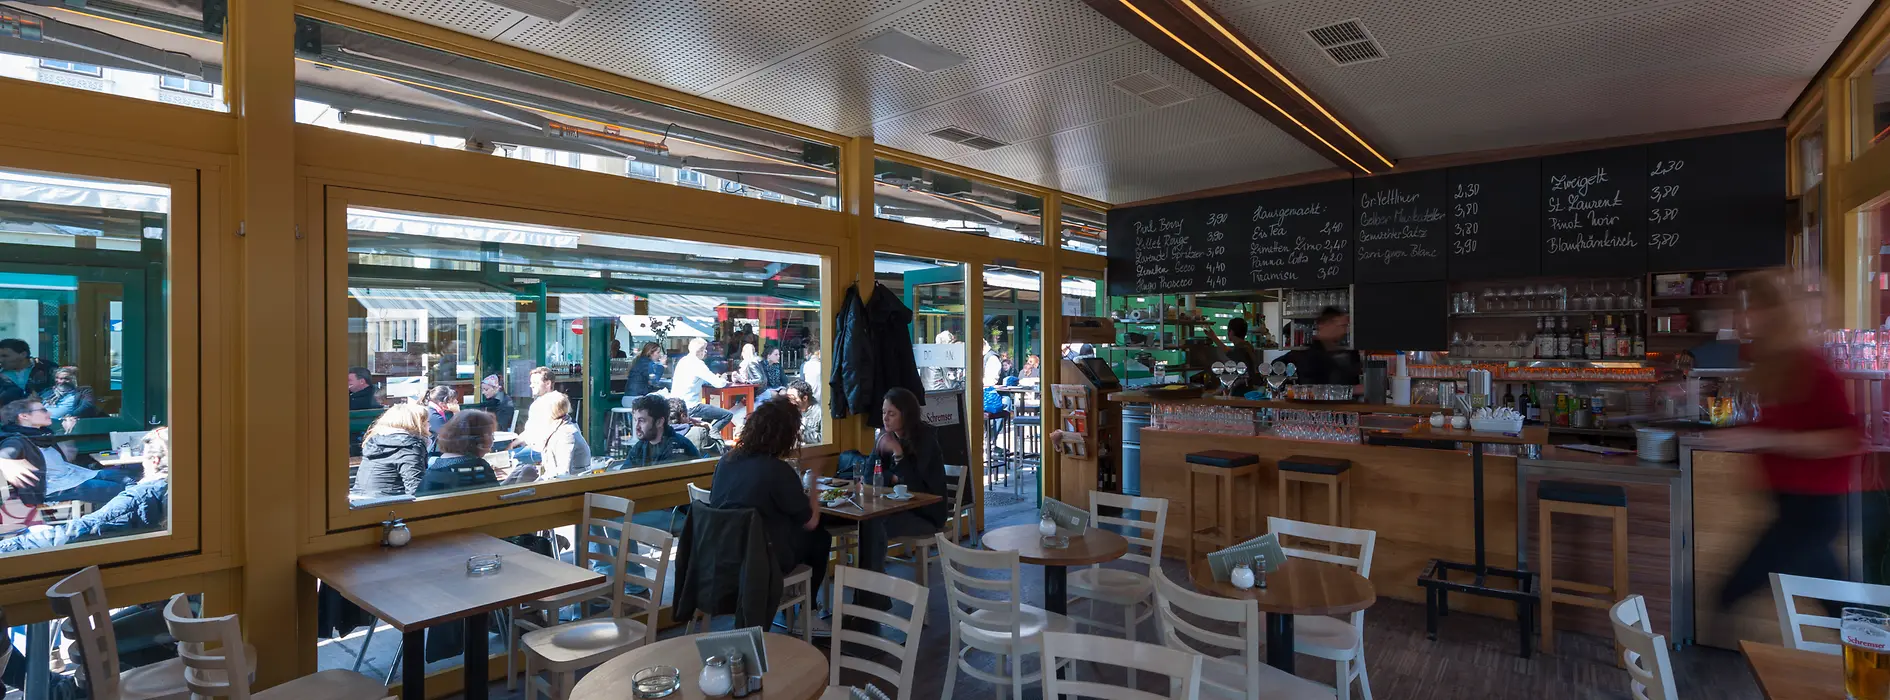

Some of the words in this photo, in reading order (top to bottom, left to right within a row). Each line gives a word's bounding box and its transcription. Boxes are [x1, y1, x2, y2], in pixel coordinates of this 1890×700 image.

[1650, 160, 1684, 176] 2,30
[1551, 167, 1608, 197] Zweigelt
[1454, 183, 1480, 199] 2,30
[1650, 184, 1680, 202] 3,80
[1568, 190, 1623, 212] Laurent
[1206, 213, 1228, 226] 3,90
[1549, 213, 1583, 230] Pinot
[1648, 208, 1679, 223] 3,80
[1252, 226, 1268, 240] Eis
[1269, 224, 1287, 236] Tea
[1320, 222, 1343, 235] 2,40
[1454, 222, 1479, 236] 3,80
[1163, 234, 1189, 251] Rouge
[1206, 231, 1224, 242] 3,90
[1546, 230, 1638, 254] Blaufränkisch
[1648, 233, 1680, 249] 3,80
[1250, 241, 1290, 255] Limetten
[1294, 236, 1322, 251] Limo
[1324, 239, 1347, 253] 2,40
[1454, 239, 1477, 255] 3,90
[1174, 261, 1196, 273] Secco
[1206, 262, 1226, 274] 4,40
[1250, 255, 1285, 268] Panna
[1206, 275, 1227, 288] 4,40
[1250, 269, 1299, 283] Tiramisu
[1136, 278, 1157, 293] Hugo
[1159, 276, 1194, 289] Prosecco
[926, 411, 953, 424] Schremser
[1847, 635, 1886, 649] Schremser
